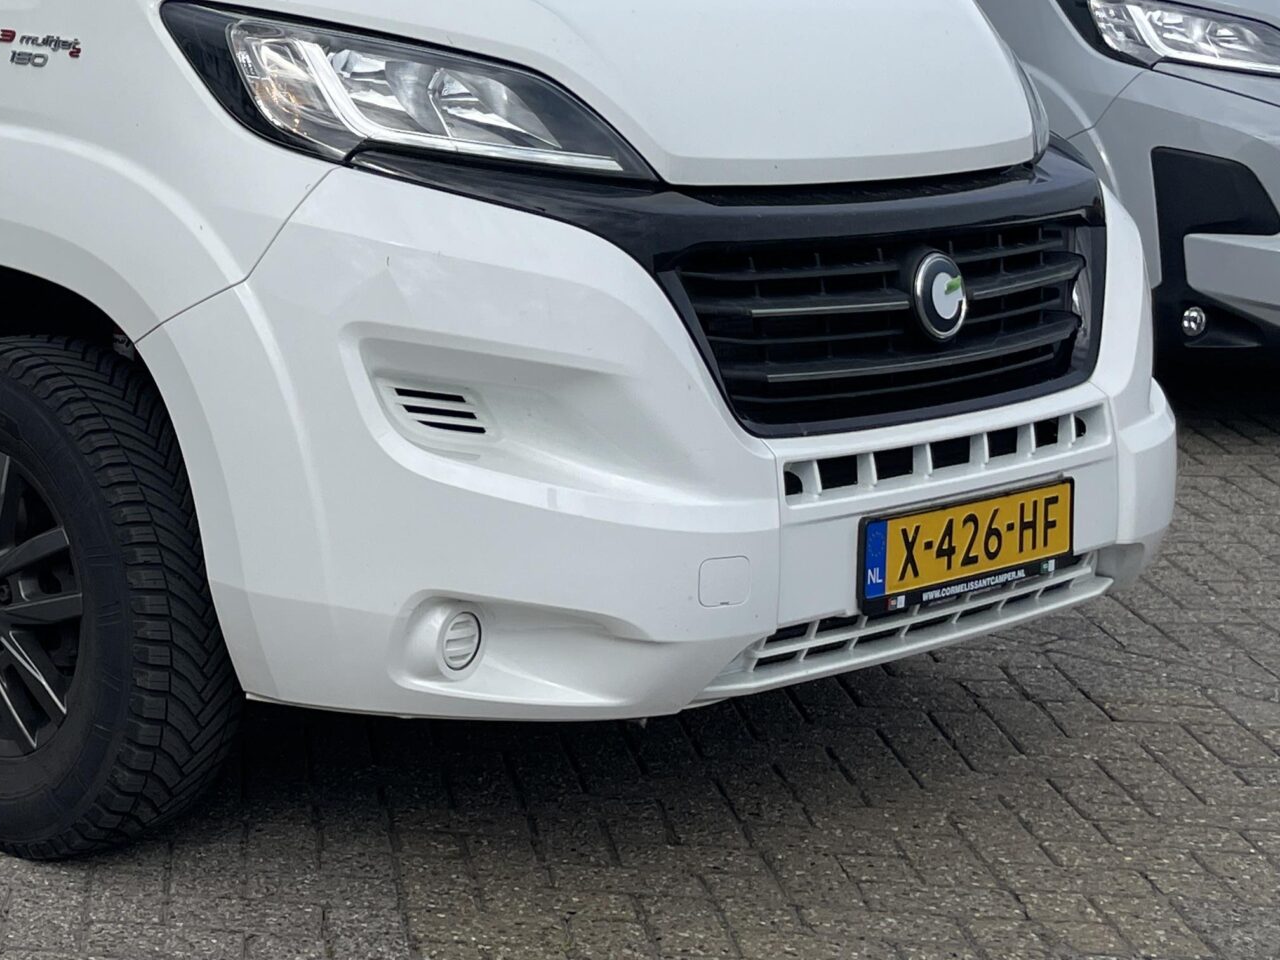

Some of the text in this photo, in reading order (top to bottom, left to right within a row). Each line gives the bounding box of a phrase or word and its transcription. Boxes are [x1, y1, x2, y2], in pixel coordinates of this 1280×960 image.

[898, 495, 1059, 582] X-426-HF
[867, 568, 884, 585] NL
[922, 568, 1026, 602] WWW.CORMELISSANTCAMPER.NL
